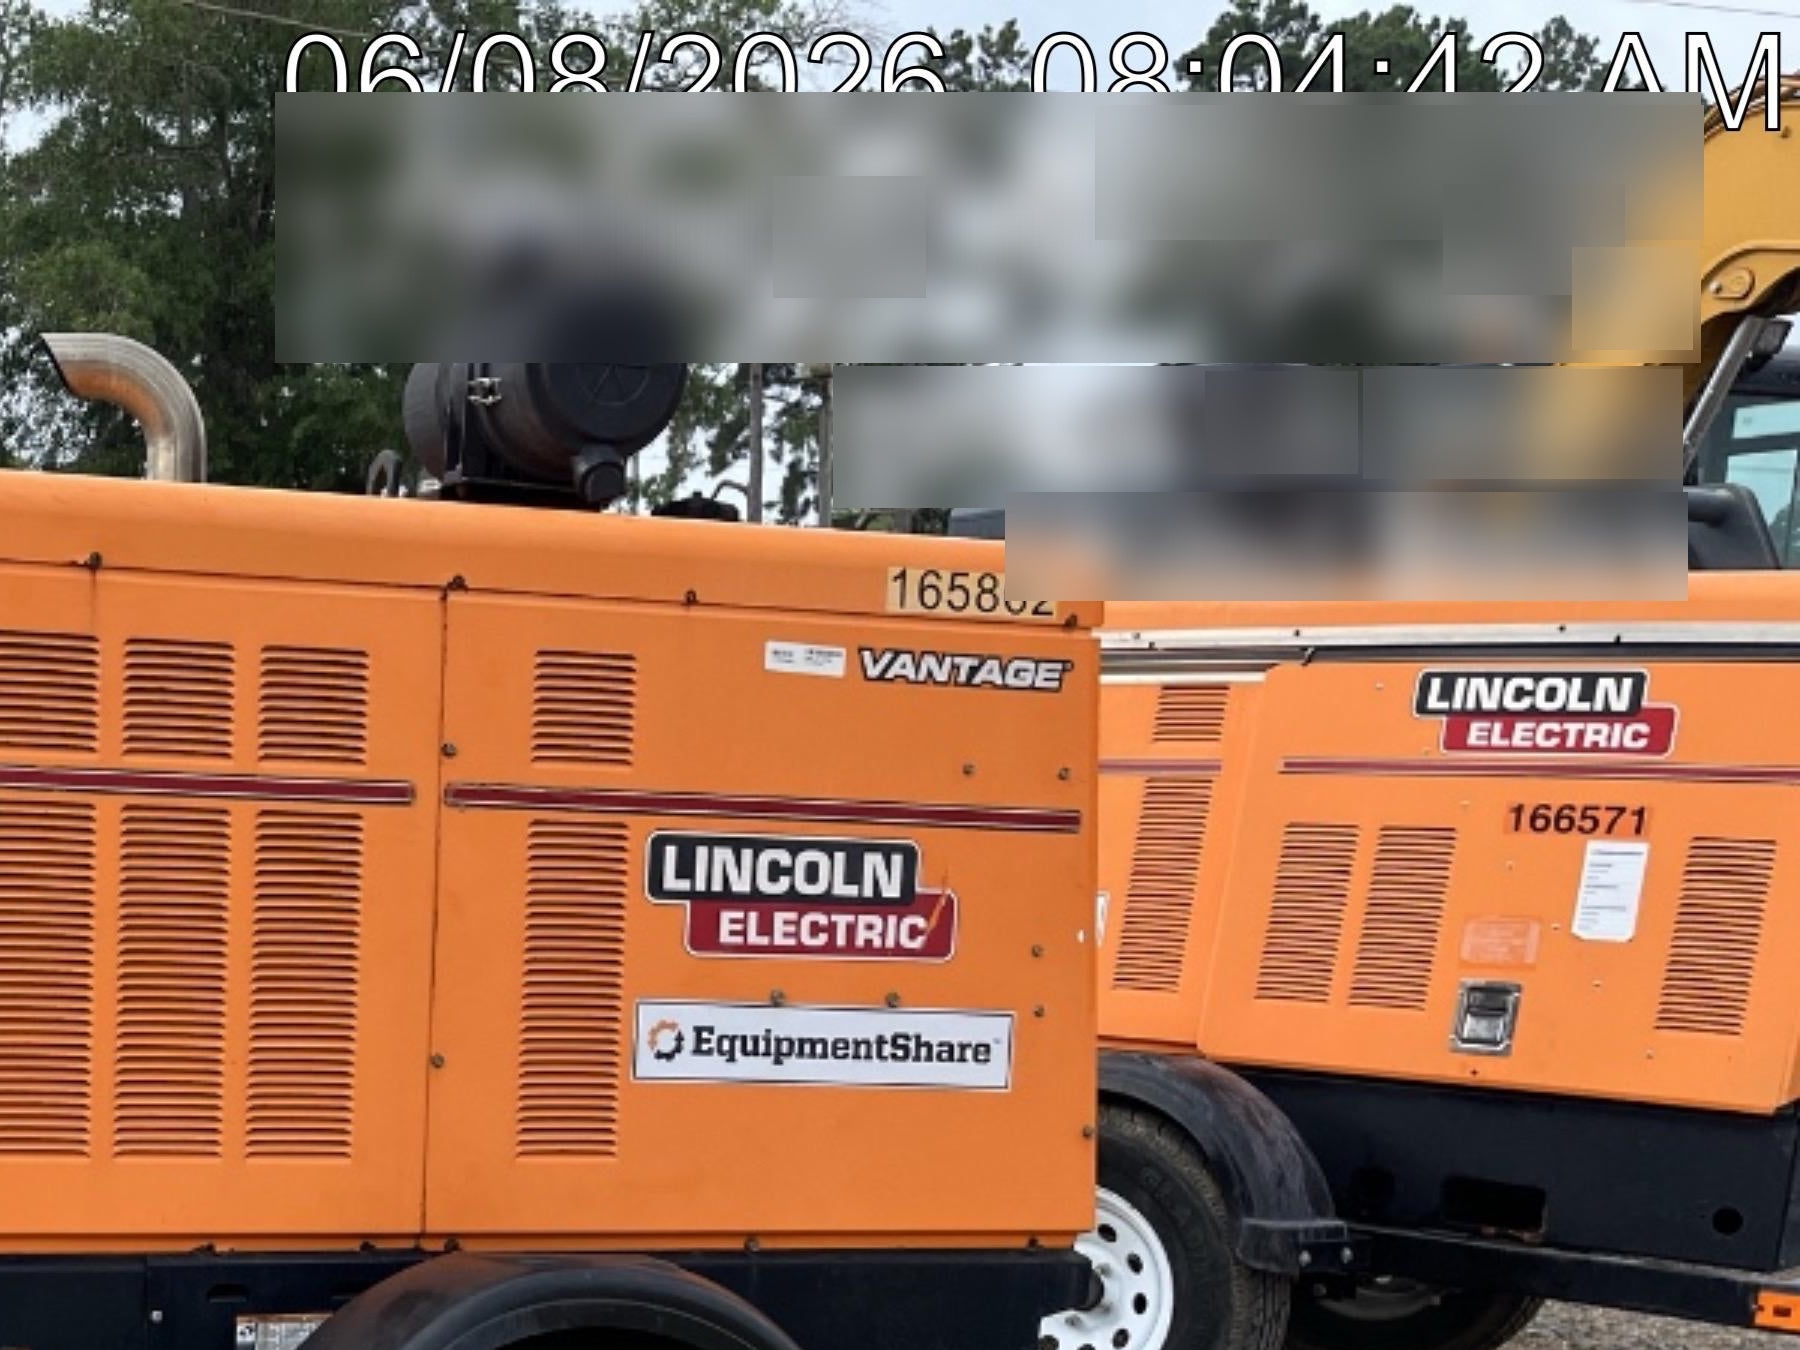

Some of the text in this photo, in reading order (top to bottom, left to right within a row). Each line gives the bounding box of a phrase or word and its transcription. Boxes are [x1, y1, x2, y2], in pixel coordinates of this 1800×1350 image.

[860, 647, 1066, 692] VANTAGE
[1426, 677, 1633, 712] LINCOLN
[1466, 721, 1651, 749] ELECTRIC
[1510, 803, 1646, 835] 166571
[662, 845, 904, 898] LINCOLN
[718, 910, 929, 950] ELECTRIC
[691, 1025, 992, 1065] EquipmentShare
